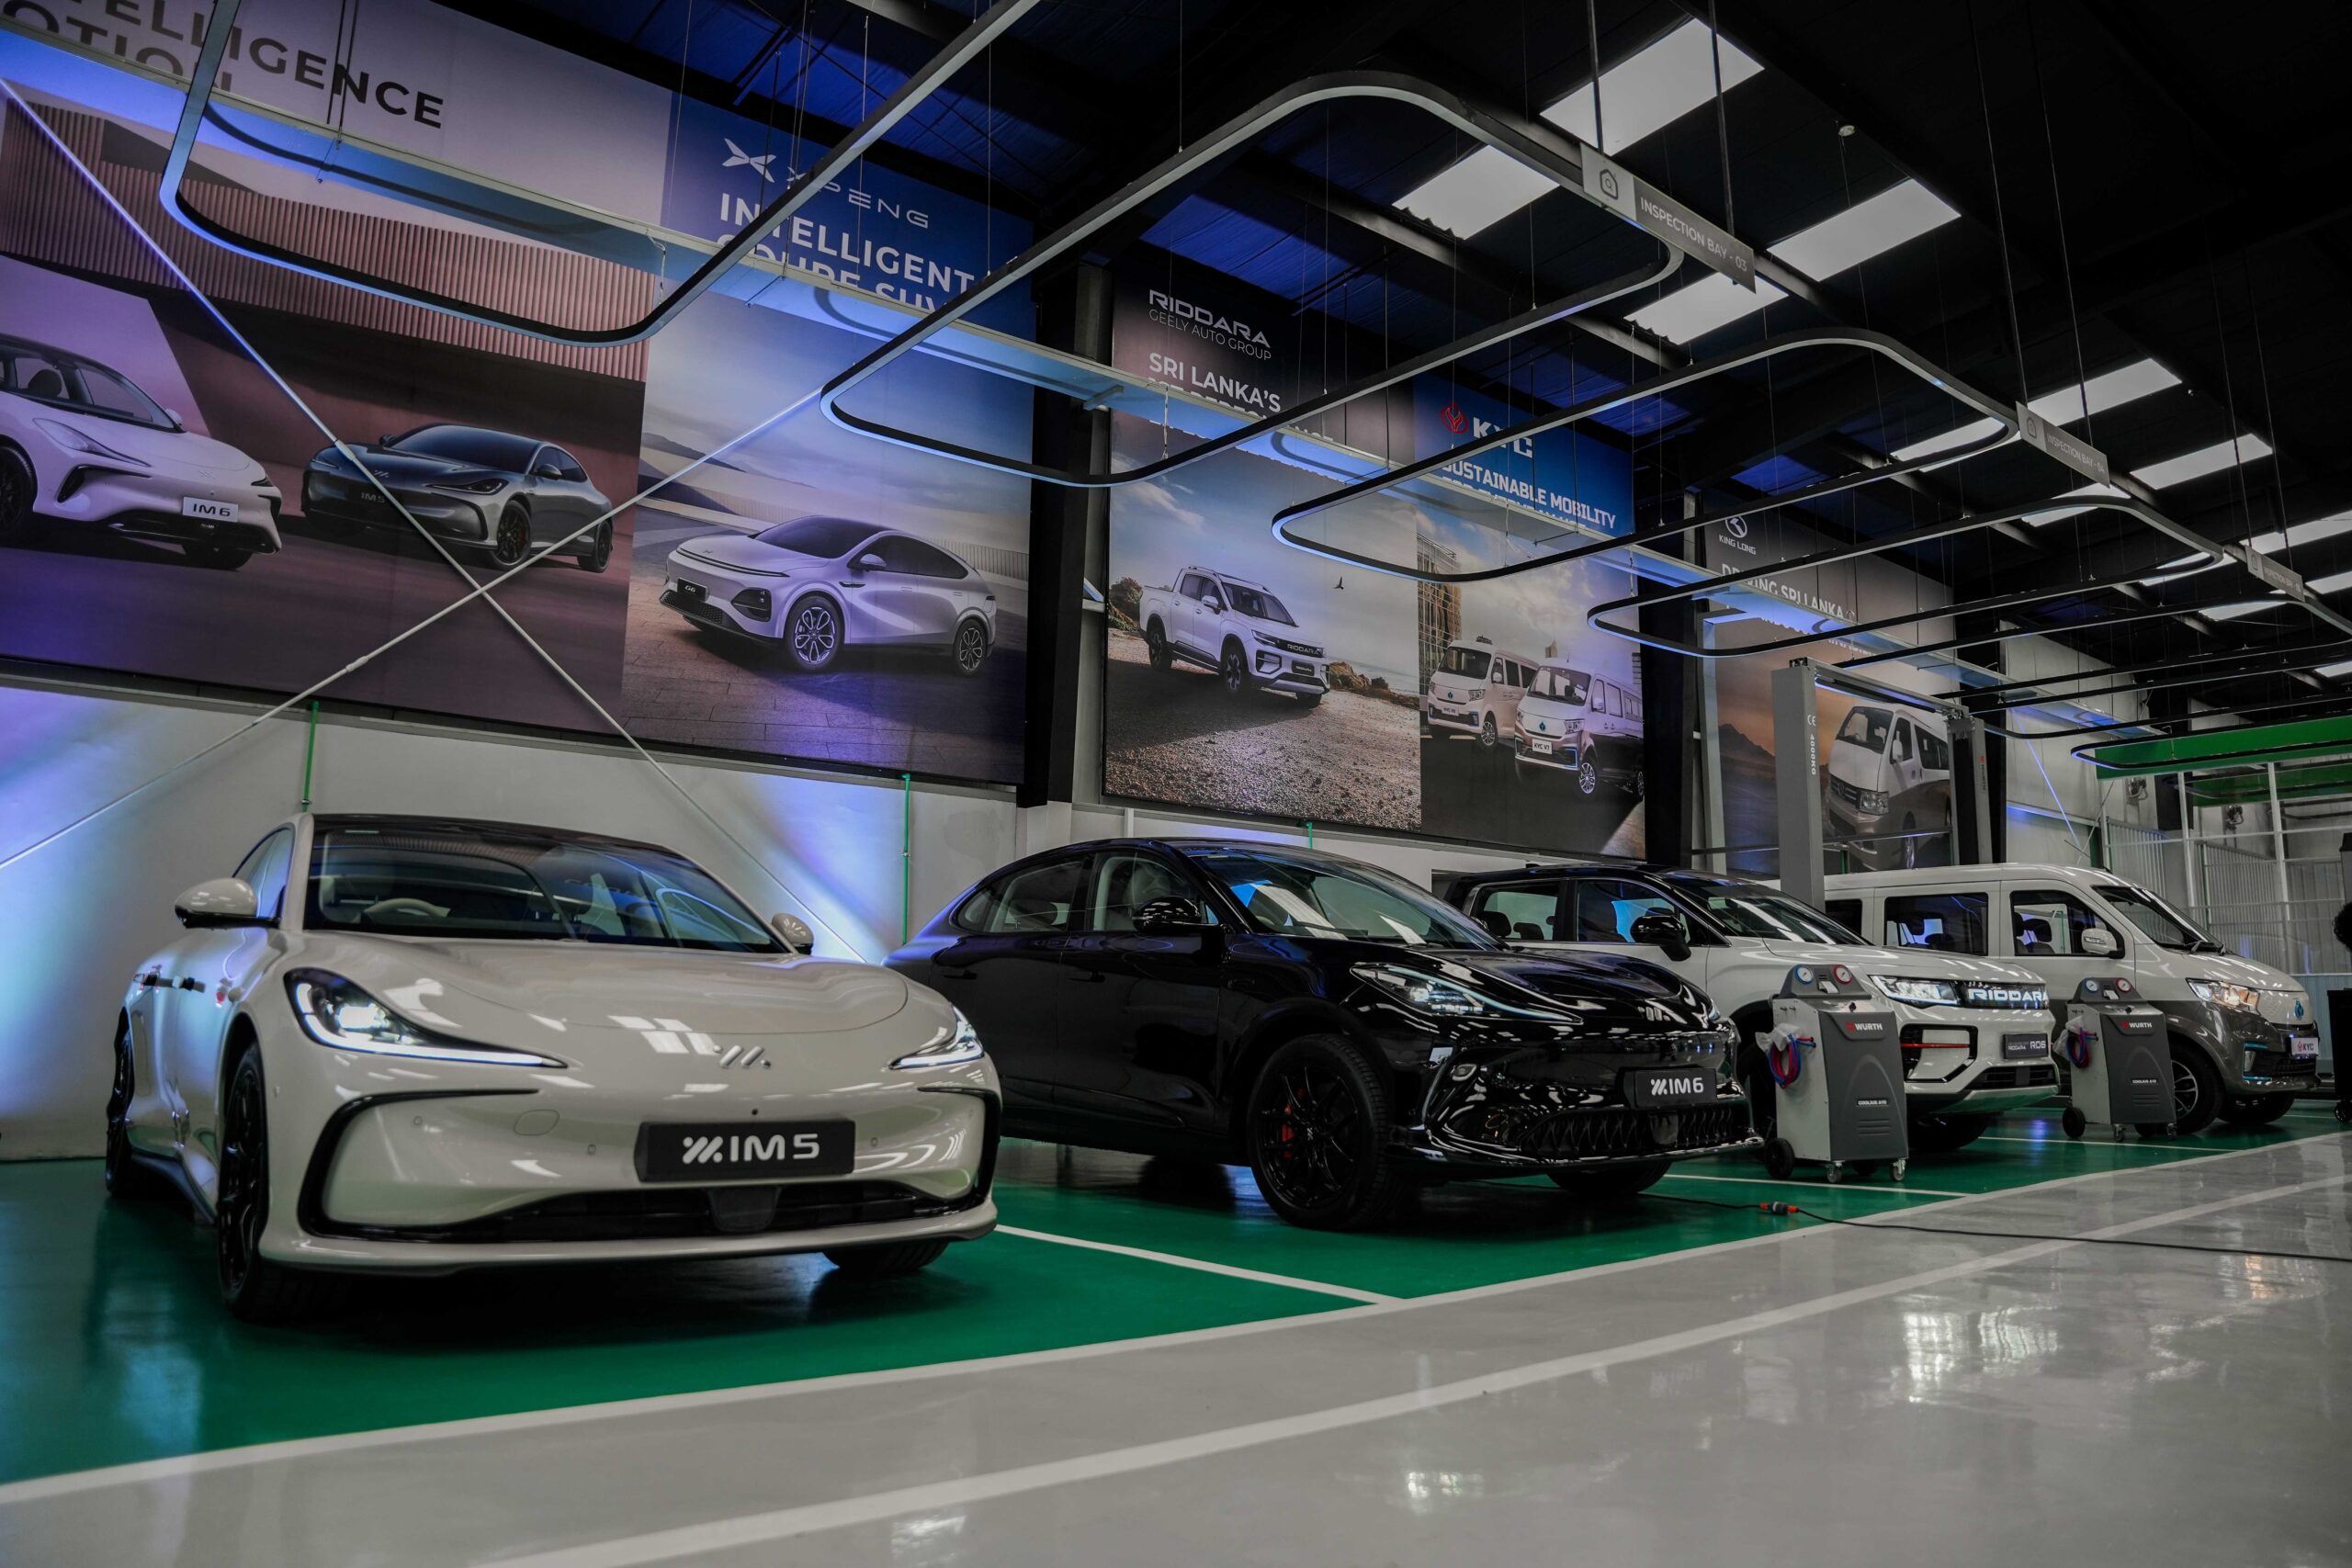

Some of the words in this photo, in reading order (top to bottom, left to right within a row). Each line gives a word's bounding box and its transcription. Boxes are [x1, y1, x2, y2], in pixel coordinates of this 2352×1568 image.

[720, 192, 975, 295] INELLIGENT
[1640, 197, 1705, 247] INSPECTION
[1707, 237, 1728, 261] BAY
[1735, 254, 1747, 272] 03
[1148, 288, 1271, 348] RIDDARA
[1148, 309, 1190, 332] GEELY
[1191, 324, 1226, 345] AUTO
[1227, 337, 1272, 361] GROUP
[1148, 352, 1184, 380] SRI
[1191, 366, 1282, 413] LANKA'S
[2046, 433, 2082, 461] INSPECTION
[193, 503, 231, 517] IM6
[1550, 492, 1616, 529] MOBILITY
[1718, 534, 1736, 547] KING
[1736, 540, 1757, 555] LONG
[1968, 987, 2049, 1001] RIDDARA
[2302, 1043, 2314, 1051] KYC
[1668, 1077, 1704, 1095] IM6
[729, 1133, 820, 1162] IM5
